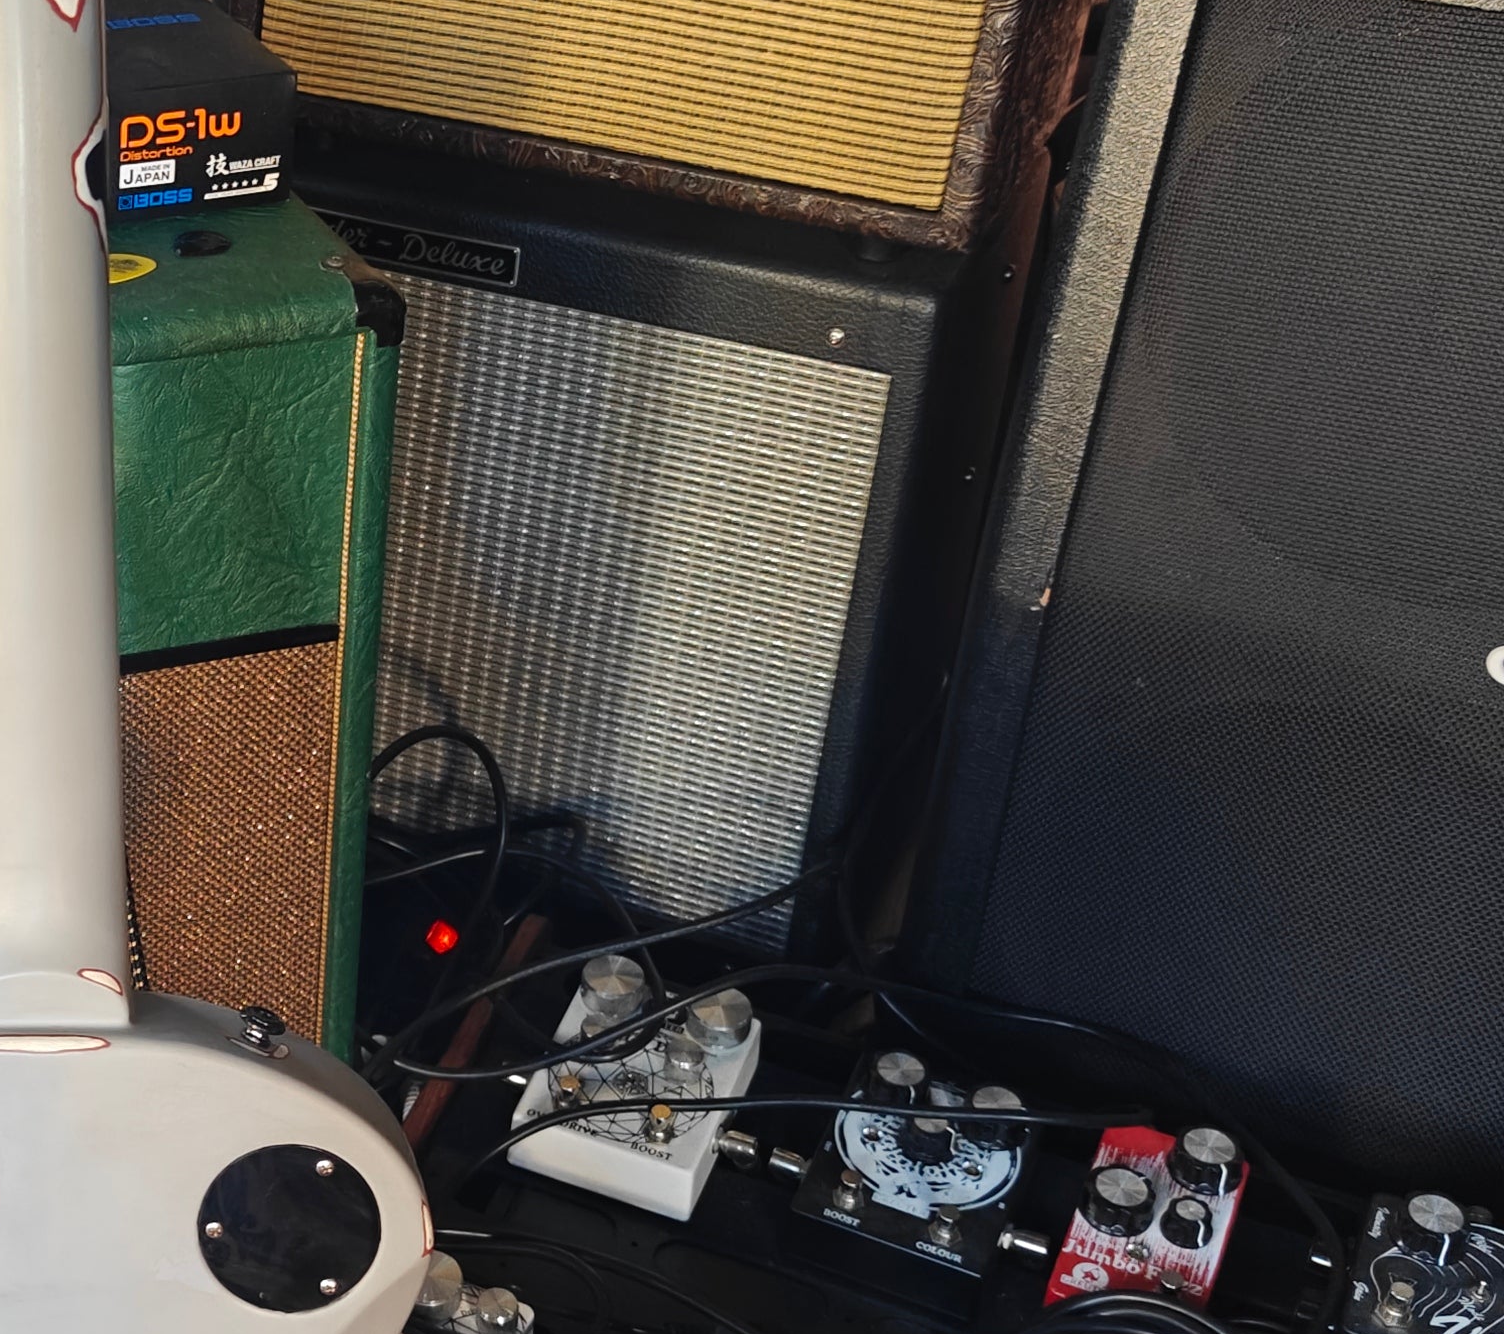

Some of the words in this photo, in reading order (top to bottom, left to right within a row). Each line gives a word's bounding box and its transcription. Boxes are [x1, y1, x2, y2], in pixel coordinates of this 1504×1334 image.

[120, 144, 194, 163] Distortion
[229, 160, 254, 171] WAZA
[254, 155, 282, 167] CRAFT
[205, 153, 230, 178] 技
[134, 188, 193, 209] BOSS
[398, 233, 506, 276] Deluxe
[630, 1141, 673, 1161] BOOST
[823, 1208, 861, 1228] BOOST
[915, 1241, 963, 1264] COLOUR
[1062, 1238, 1141, 1275] Jumbo
